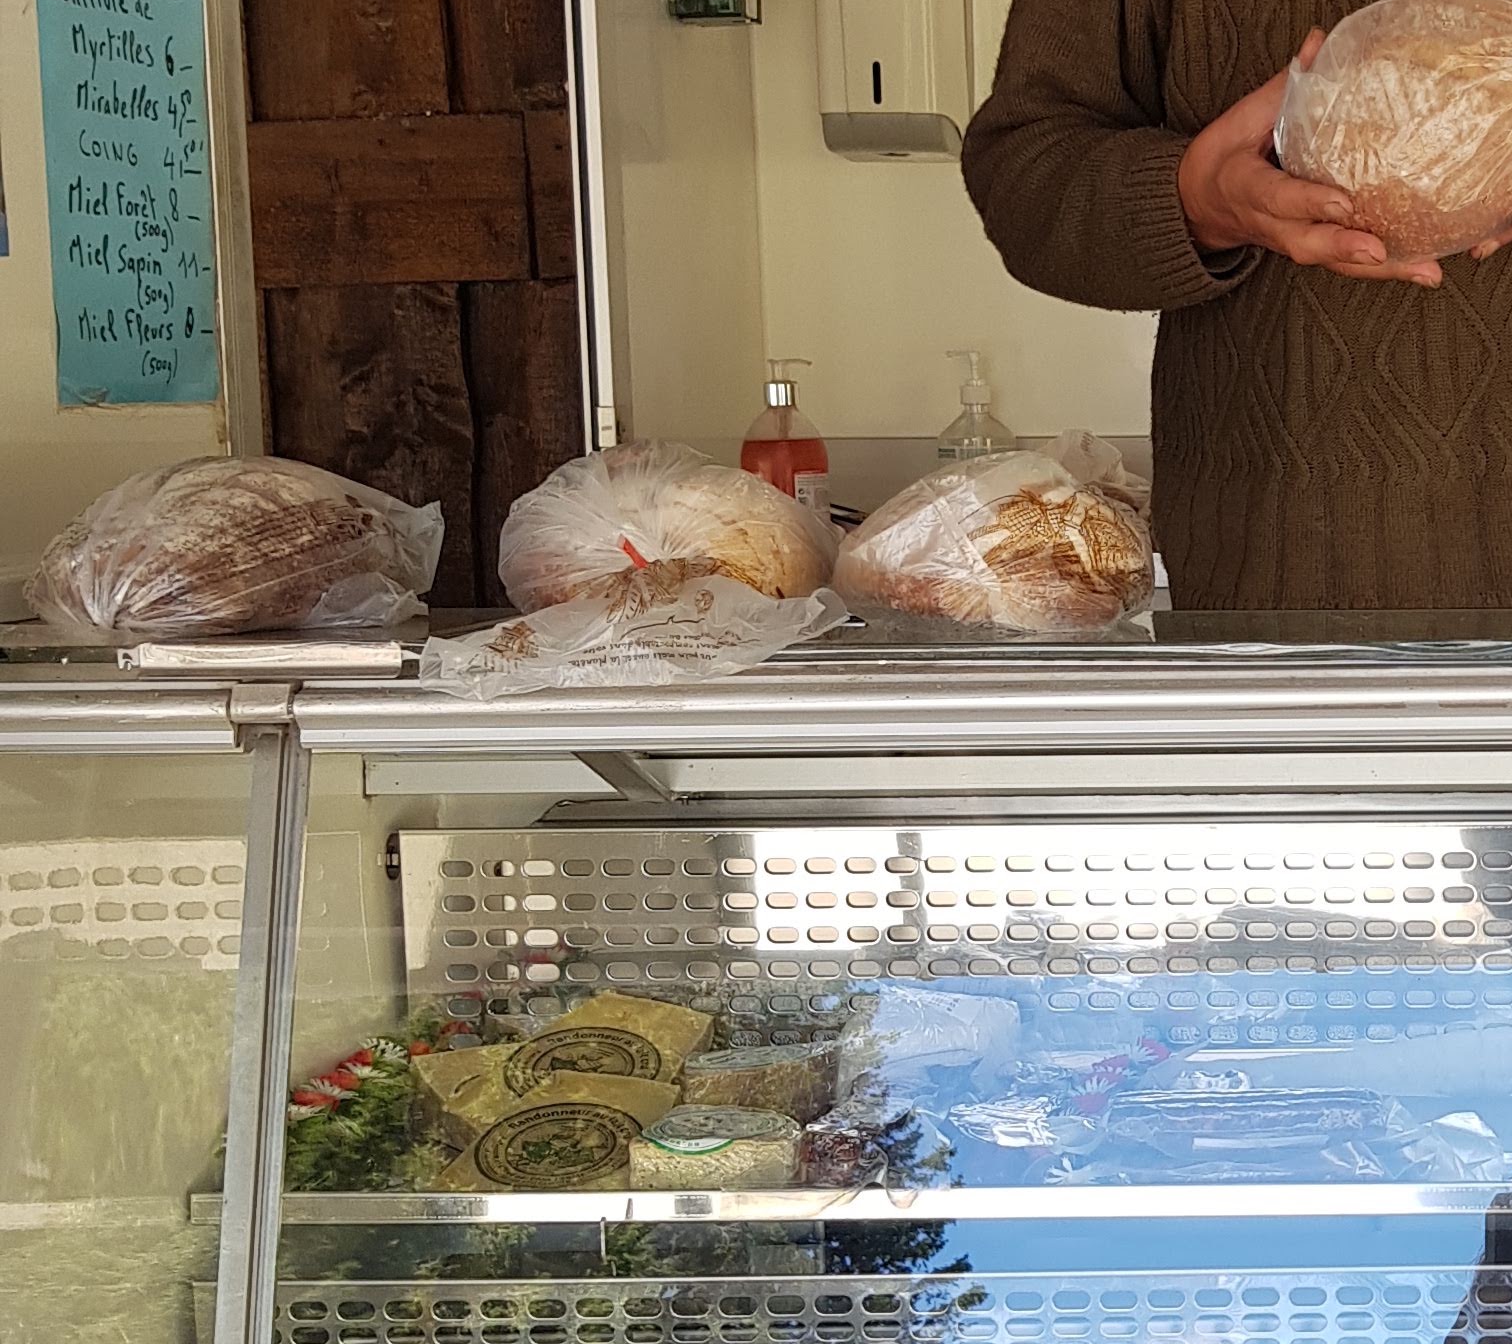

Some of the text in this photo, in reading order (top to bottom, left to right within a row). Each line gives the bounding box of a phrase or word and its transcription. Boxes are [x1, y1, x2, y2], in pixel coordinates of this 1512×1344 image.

[72, 23, 155, 80] Myrtilles
[76, 79, 160, 121] Mirabelles
[79, 128, 139, 167] COING
[68, 175, 108, 217] Miel
[116, 181, 157, 221] Forêt
[69, 234, 110, 275] Miel
[117, 243, 163, 286] Sapin
[78, 306, 118, 345] Miel
[125, 307, 174, 346] Fleurs
